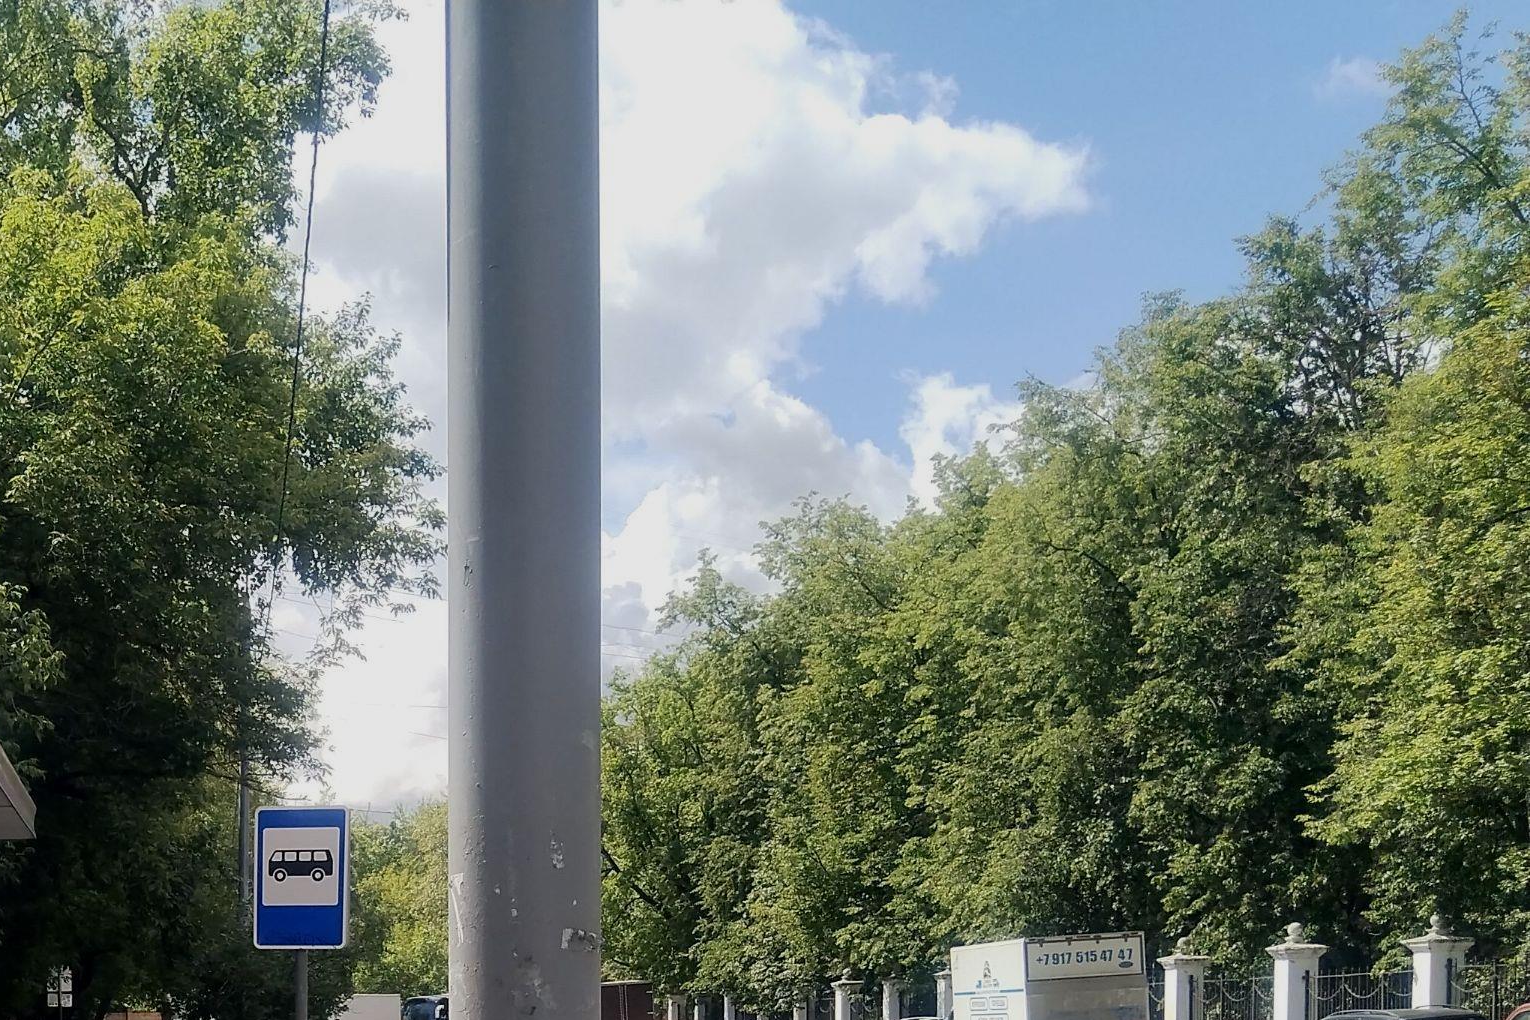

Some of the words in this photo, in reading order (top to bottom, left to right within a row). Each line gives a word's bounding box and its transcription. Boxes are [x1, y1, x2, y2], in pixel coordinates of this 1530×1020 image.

[1036, 953, 1049, 965] +7
[1051, 952, 1072, 965] 917
[1100, 949, 1113, 961] 47
[1117, 948, 1133, 960] 47
